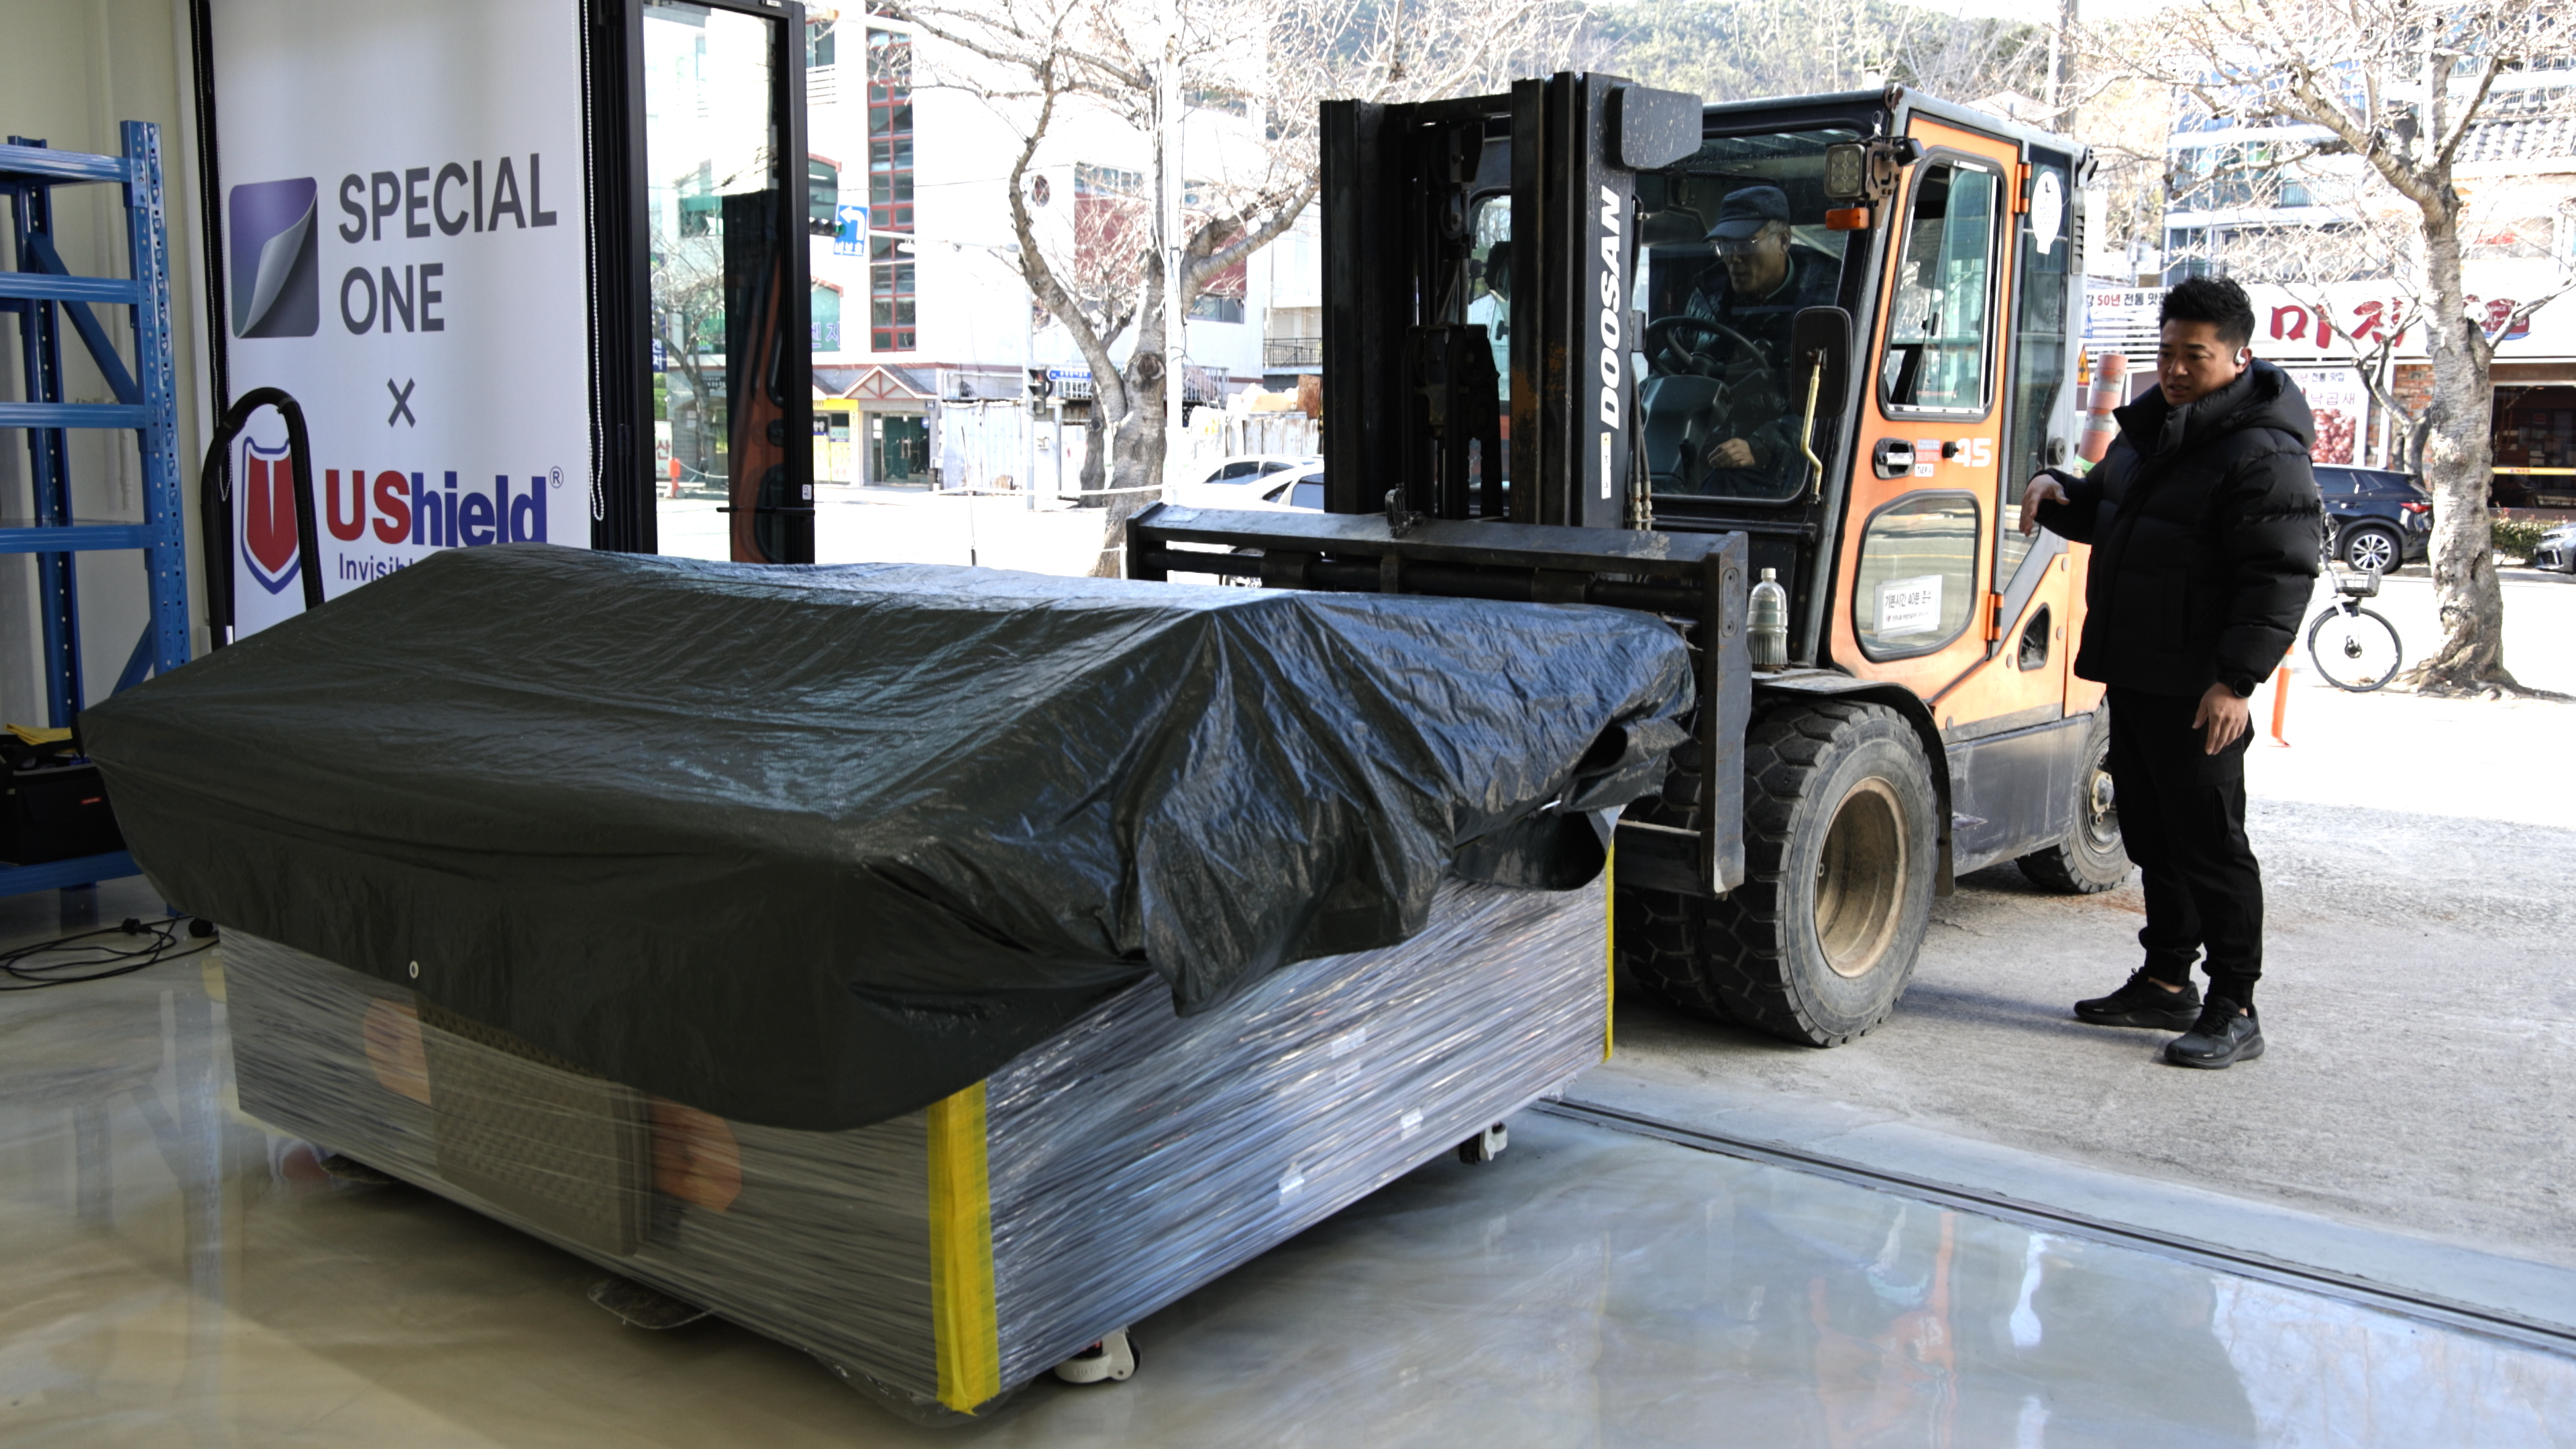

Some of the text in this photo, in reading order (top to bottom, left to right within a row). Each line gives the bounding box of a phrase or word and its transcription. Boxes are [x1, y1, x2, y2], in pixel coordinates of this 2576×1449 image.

[339, 153, 557, 244] SPECIAL
[835, 241, 863, 255] 비보호
[340, 262, 444, 335] ONE
[1601, 185, 1620, 429] DOOSAN
[2098, 294, 2121, 307] 50년
[2125, 292, 2144, 306] 전통
[2330, 372, 2345, 382] 맛집
[2311, 392, 2355, 405] 낙곱새
[1884, 590, 1932, 609] 기본시간 40분 준수
